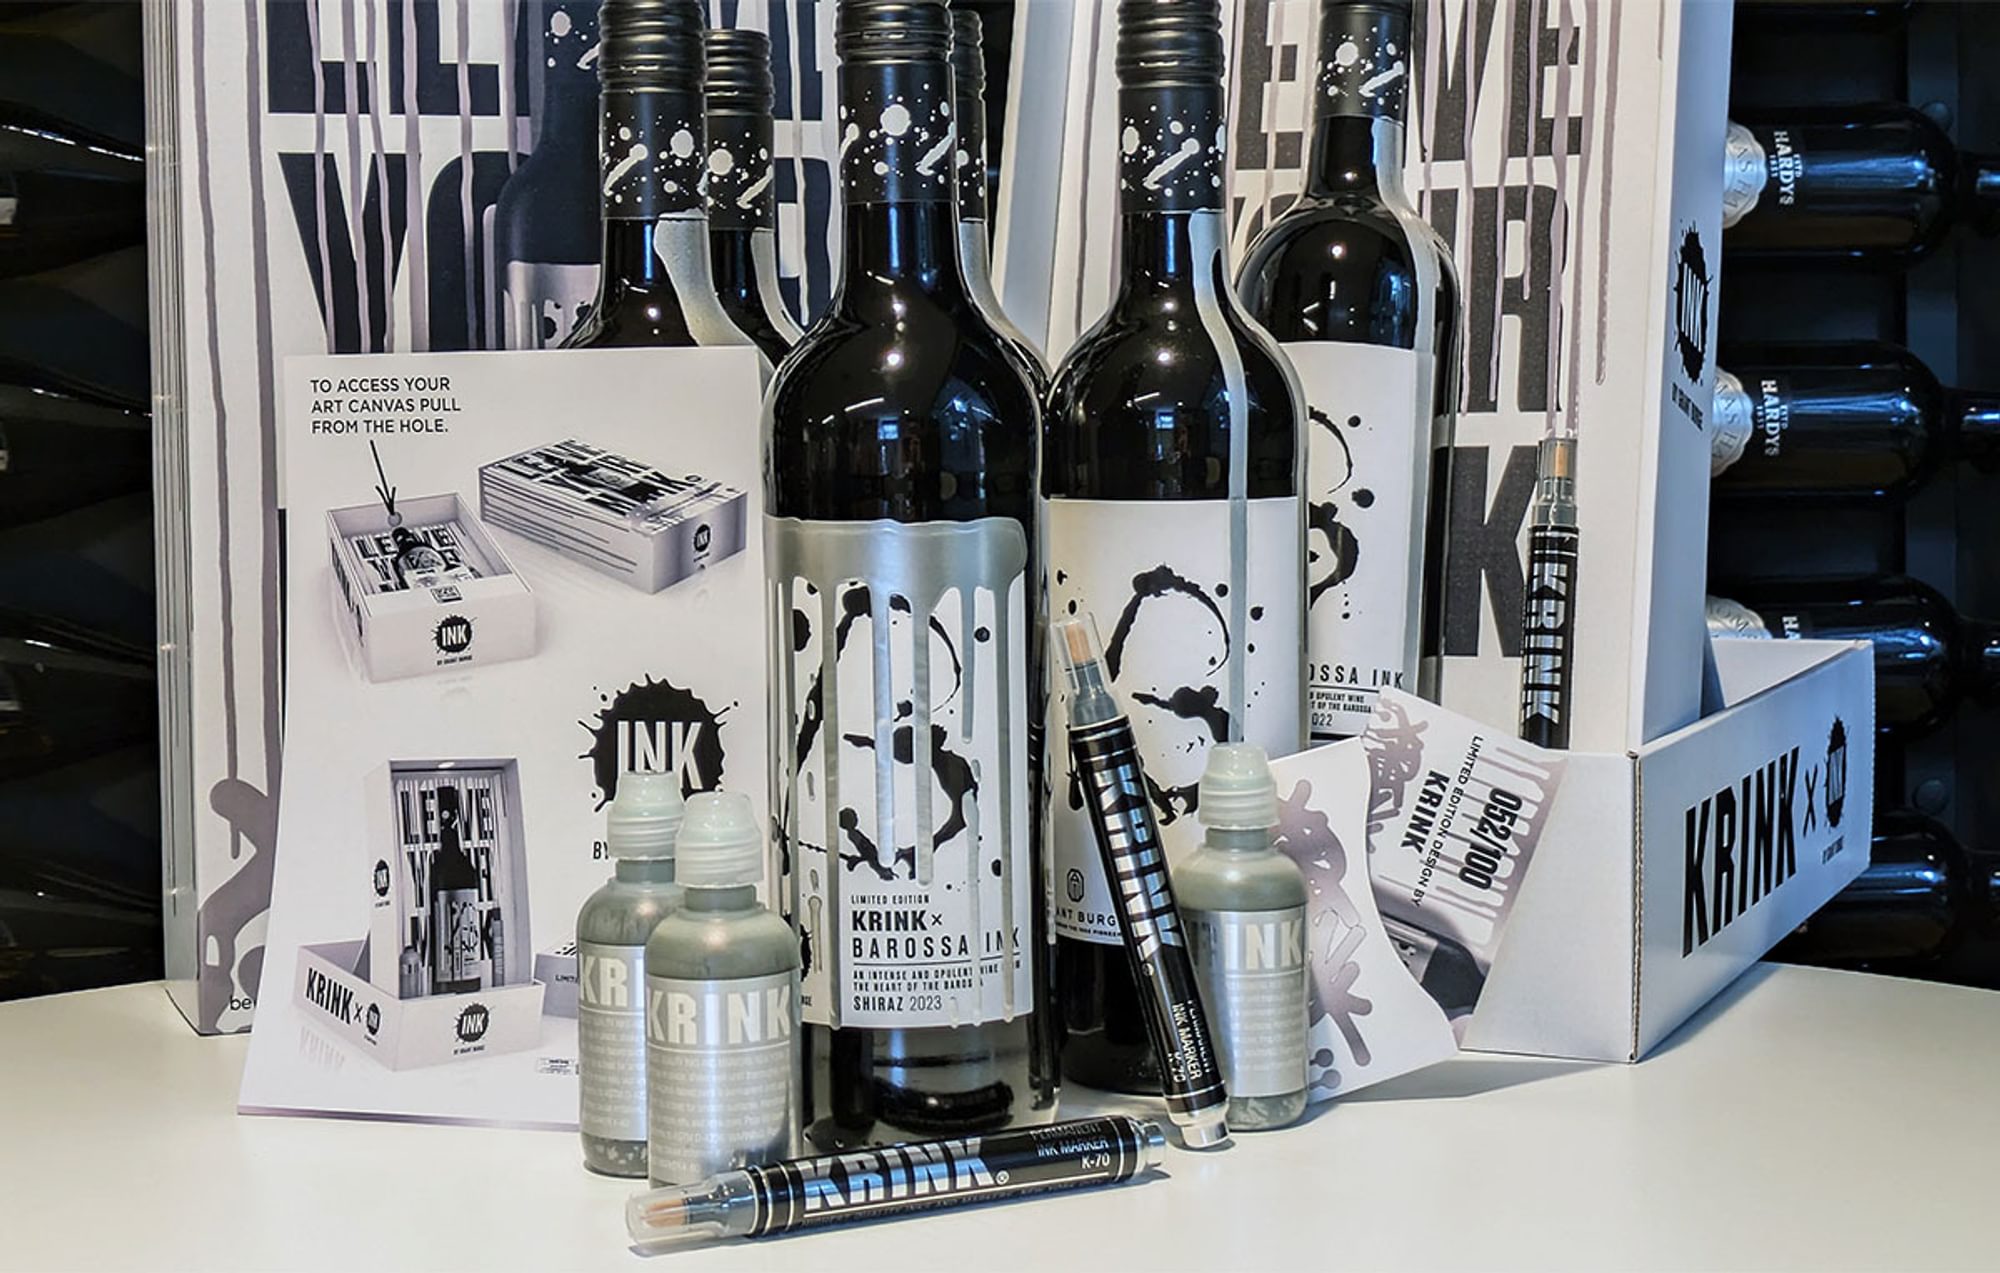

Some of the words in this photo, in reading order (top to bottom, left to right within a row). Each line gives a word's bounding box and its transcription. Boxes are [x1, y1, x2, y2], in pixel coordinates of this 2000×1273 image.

[1773, 131, 1795, 205] HARDYS
[310, 379, 332, 393] TO
[337, 378, 400, 393] ACCESS
[404, 377, 450, 392] YOUR
[311, 399, 343, 413] ART
[348, 399, 415, 413] CANVAS
[420, 398, 461, 412] PULL
[312, 420, 358, 434] FROM
[363, 419, 395, 433] THE
[400, 418, 448, 433] HOLE.
[1761, 380, 1780, 456] HARDYS
[441, 624, 468, 647] INK
[1522, 562, 1569, 724] KRINK
[1372, 669, 1403, 689] INK
[1311, 712, 1333, 726] 022
[617, 721, 703, 790] INK
[1457, 735, 1483, 785] LIMITED
[1400, 770, 1450, 854] KRINK
[1438, 786, 1465, 838] EDITION
[1459, 787, 1523, 890] 052/100
[1419, 838, 1444, 887] DESIGN
[1682, 745, 1800, 959] KRINK
[851, 895, 888, 905] LIMITED
[892, 894, 930, 904] EDITION
[1411, 888, 1426, 907] BY
[852, 910, 927, 931] KRINK
[1078, 911, 1116, 927] BURG
[853, 935, 969, 959] BAROSSA
[579, 953, 645, 1008] KRI
[853, 970, 864, 980] AN
[868, 970, 907, 980] INTENSE
[912, 970, 929, 980] AND
[934, 967, 973, 979] OPULENT
[306, 967, 354, 1025] KRINK
[853, 982, 869, 992] THE
[874, 982, 902, 992] HEART
[907, 982, 918, 992] OF
[923, 981, 939, 991] THE
[647, 984, 791, 1045] KRINK
[853, 996, 904, 1012] SHIRAZ
[909, 995, 943, 1012] 2023
[461, 1012, 485, 1035] INK
[1171, 1001, 1188, 1027] INK
[1180, 1027, 1203, 1080] MARKER
[1037, 1143, 1059, 1157] INK
[1060, 1139, 1109, 1155] MARKER
[1081, 1154, 1110, 1169] K-70
